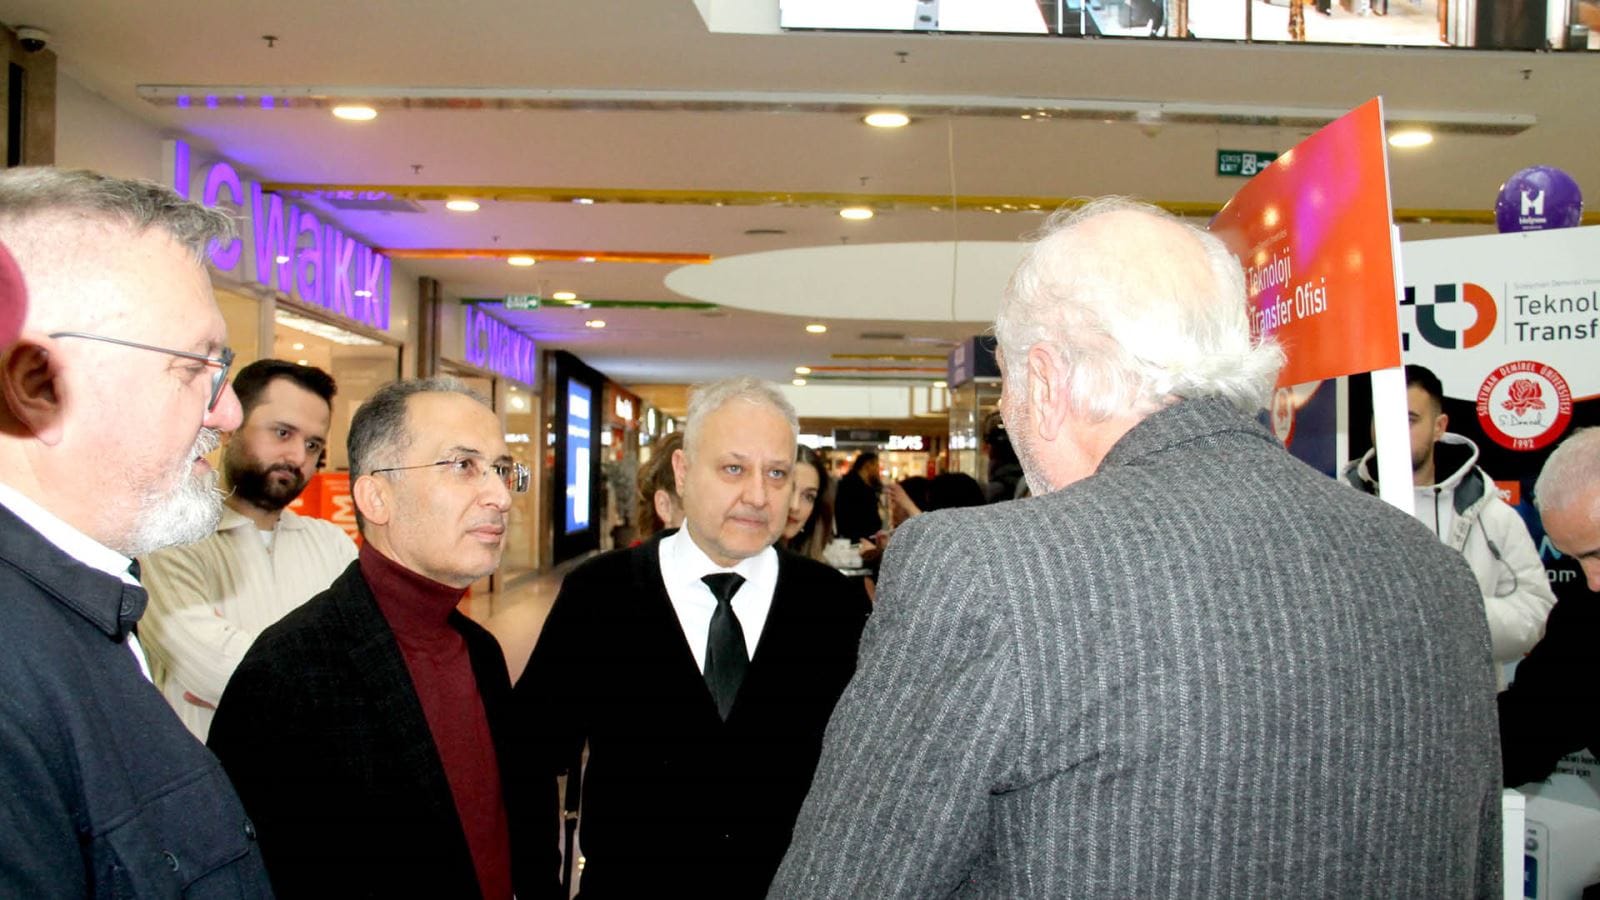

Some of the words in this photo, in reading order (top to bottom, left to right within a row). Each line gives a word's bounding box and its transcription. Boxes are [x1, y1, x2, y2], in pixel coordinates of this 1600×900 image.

[1248, 246, 1291, 297] Teknoloji
[1250, 294, 1293, 335] Transfer
[1295, 276, 1327, 319] Ofisi
[1512, 438, 1536, 449] 1992
